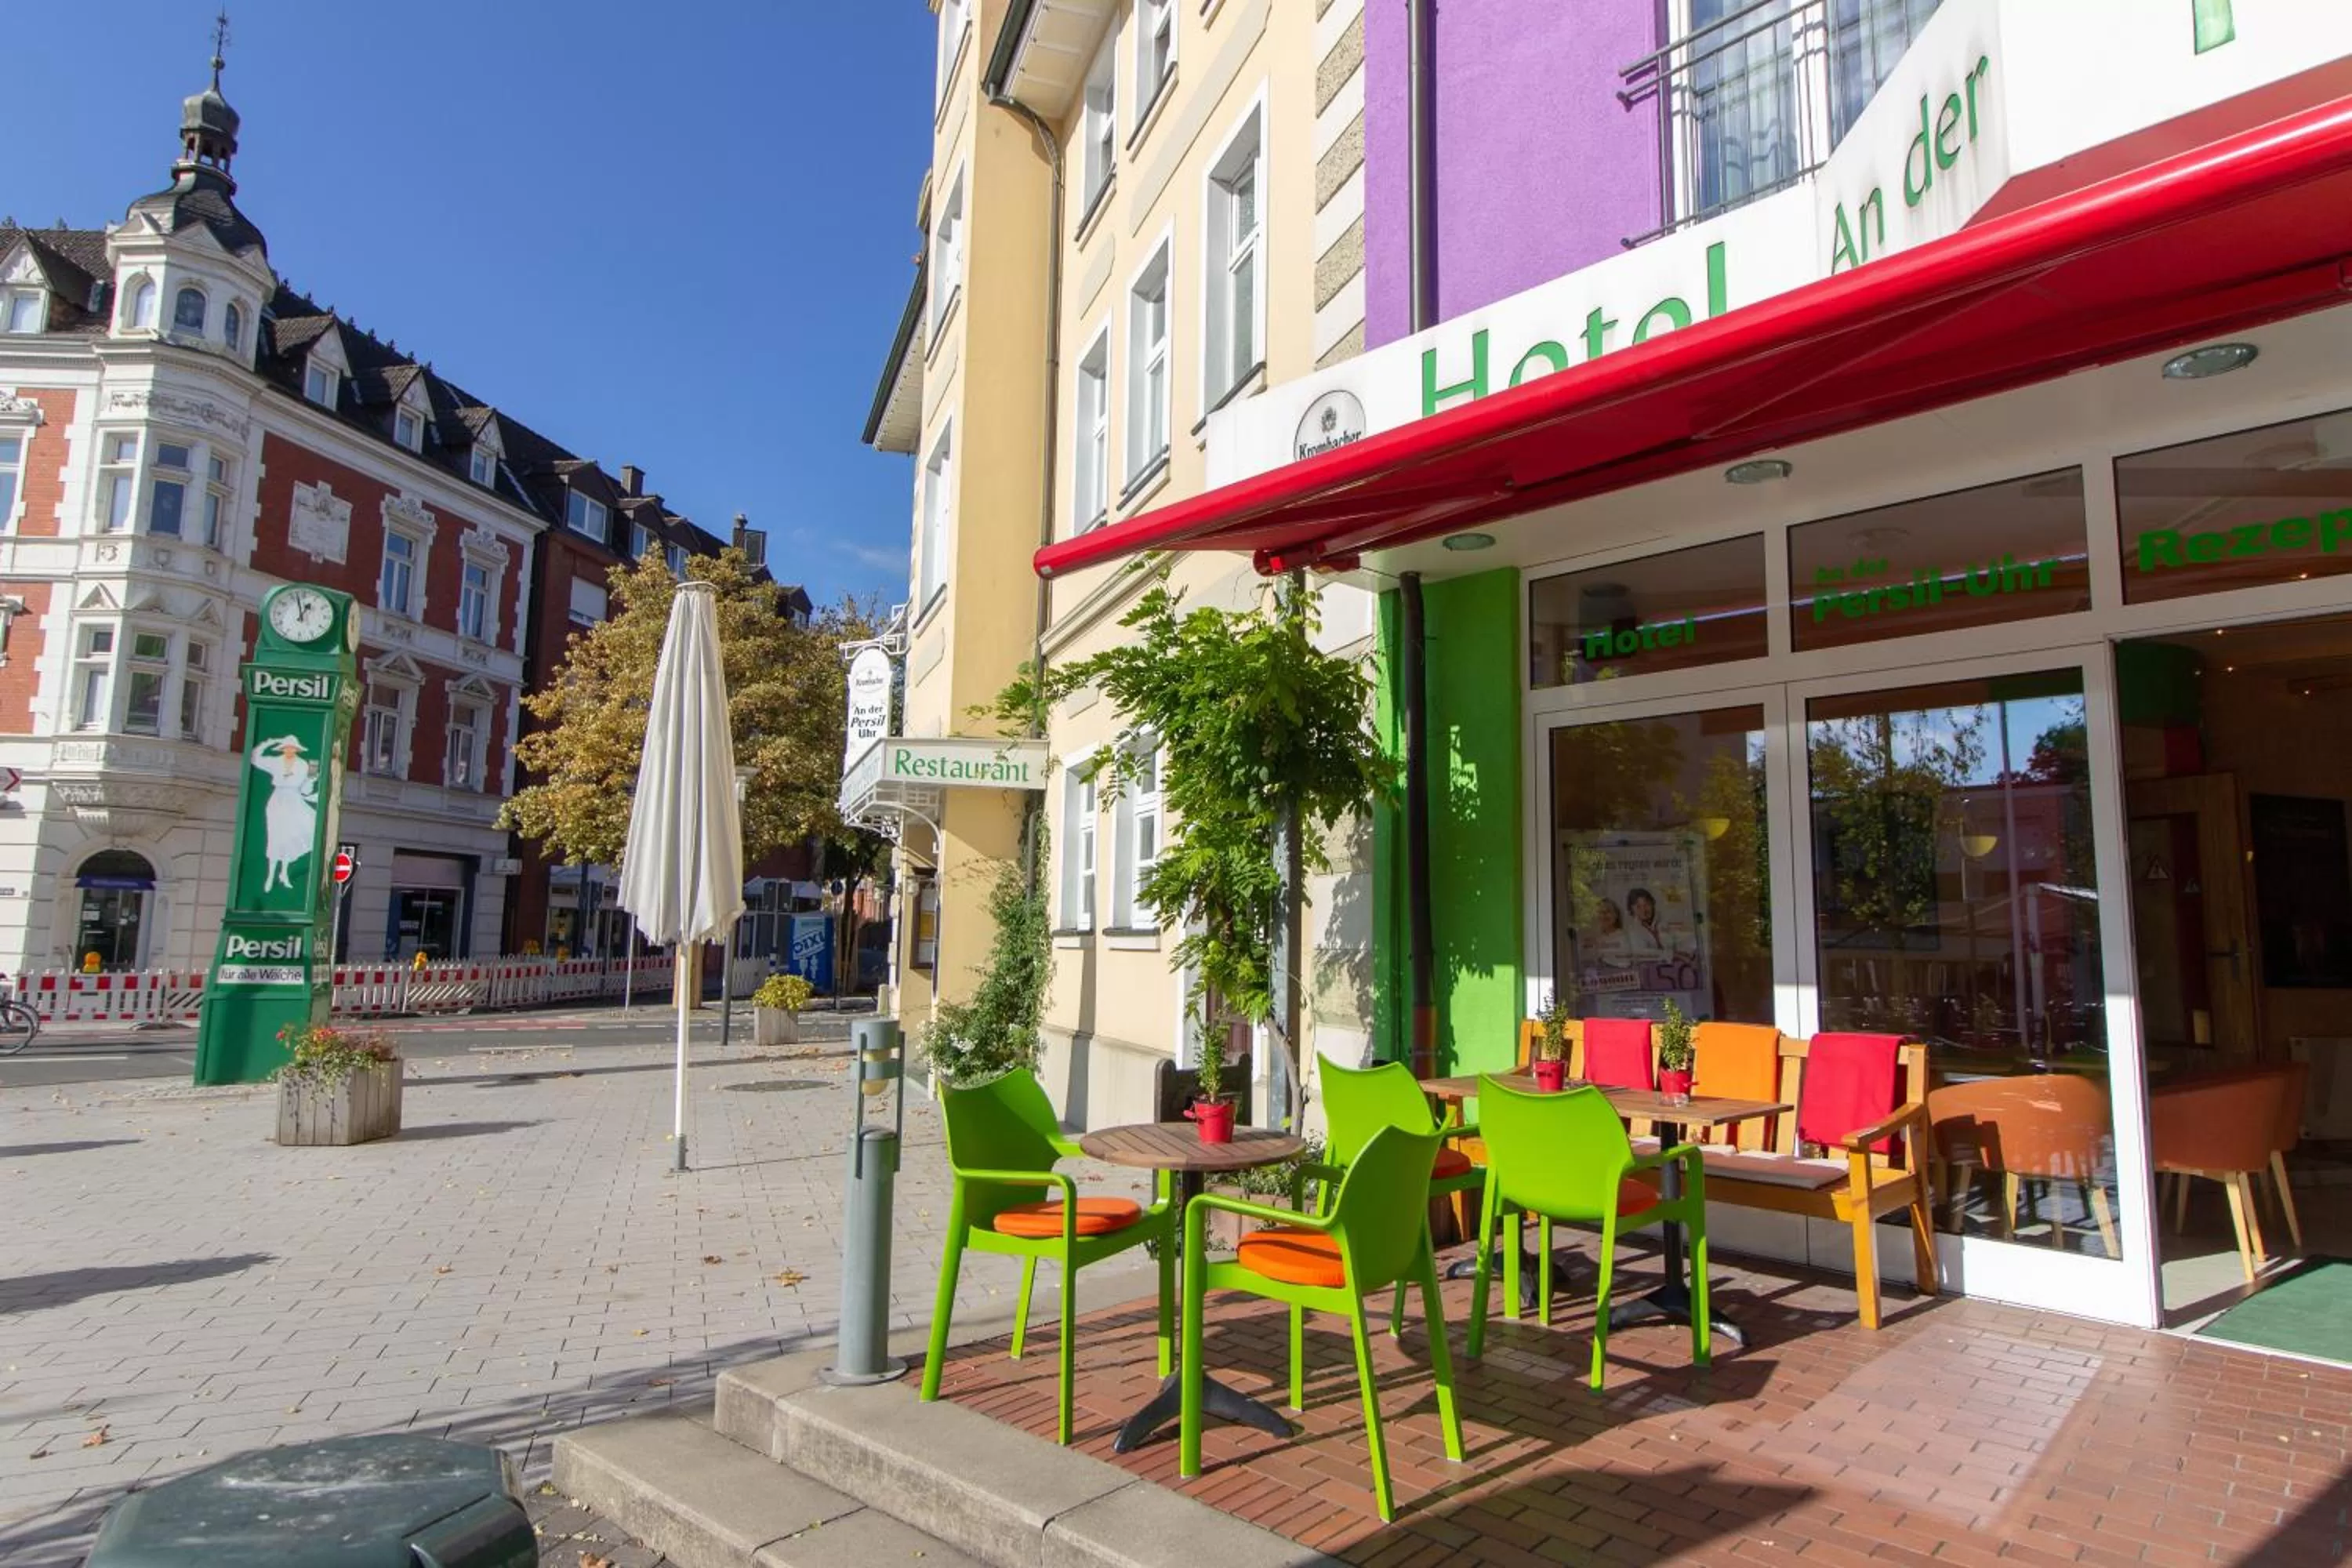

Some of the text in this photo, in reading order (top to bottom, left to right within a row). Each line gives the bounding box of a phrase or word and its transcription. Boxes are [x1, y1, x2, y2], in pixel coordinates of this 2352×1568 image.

[1831, 55, 1989, 275] An der
[1813, 551, 2058, 623] Persil-Uhr
[1585, 610, 1695, 659] Hotel
[253, 671, 329, 699] Persil
[851, 714, 887, 728] Persil
[854, 705, 884, 715] An der
[858, 728, 877, 739] Uhr
[895, 748, 1029, 782] Restaurant
[226, 935, 302, 959] Persil
